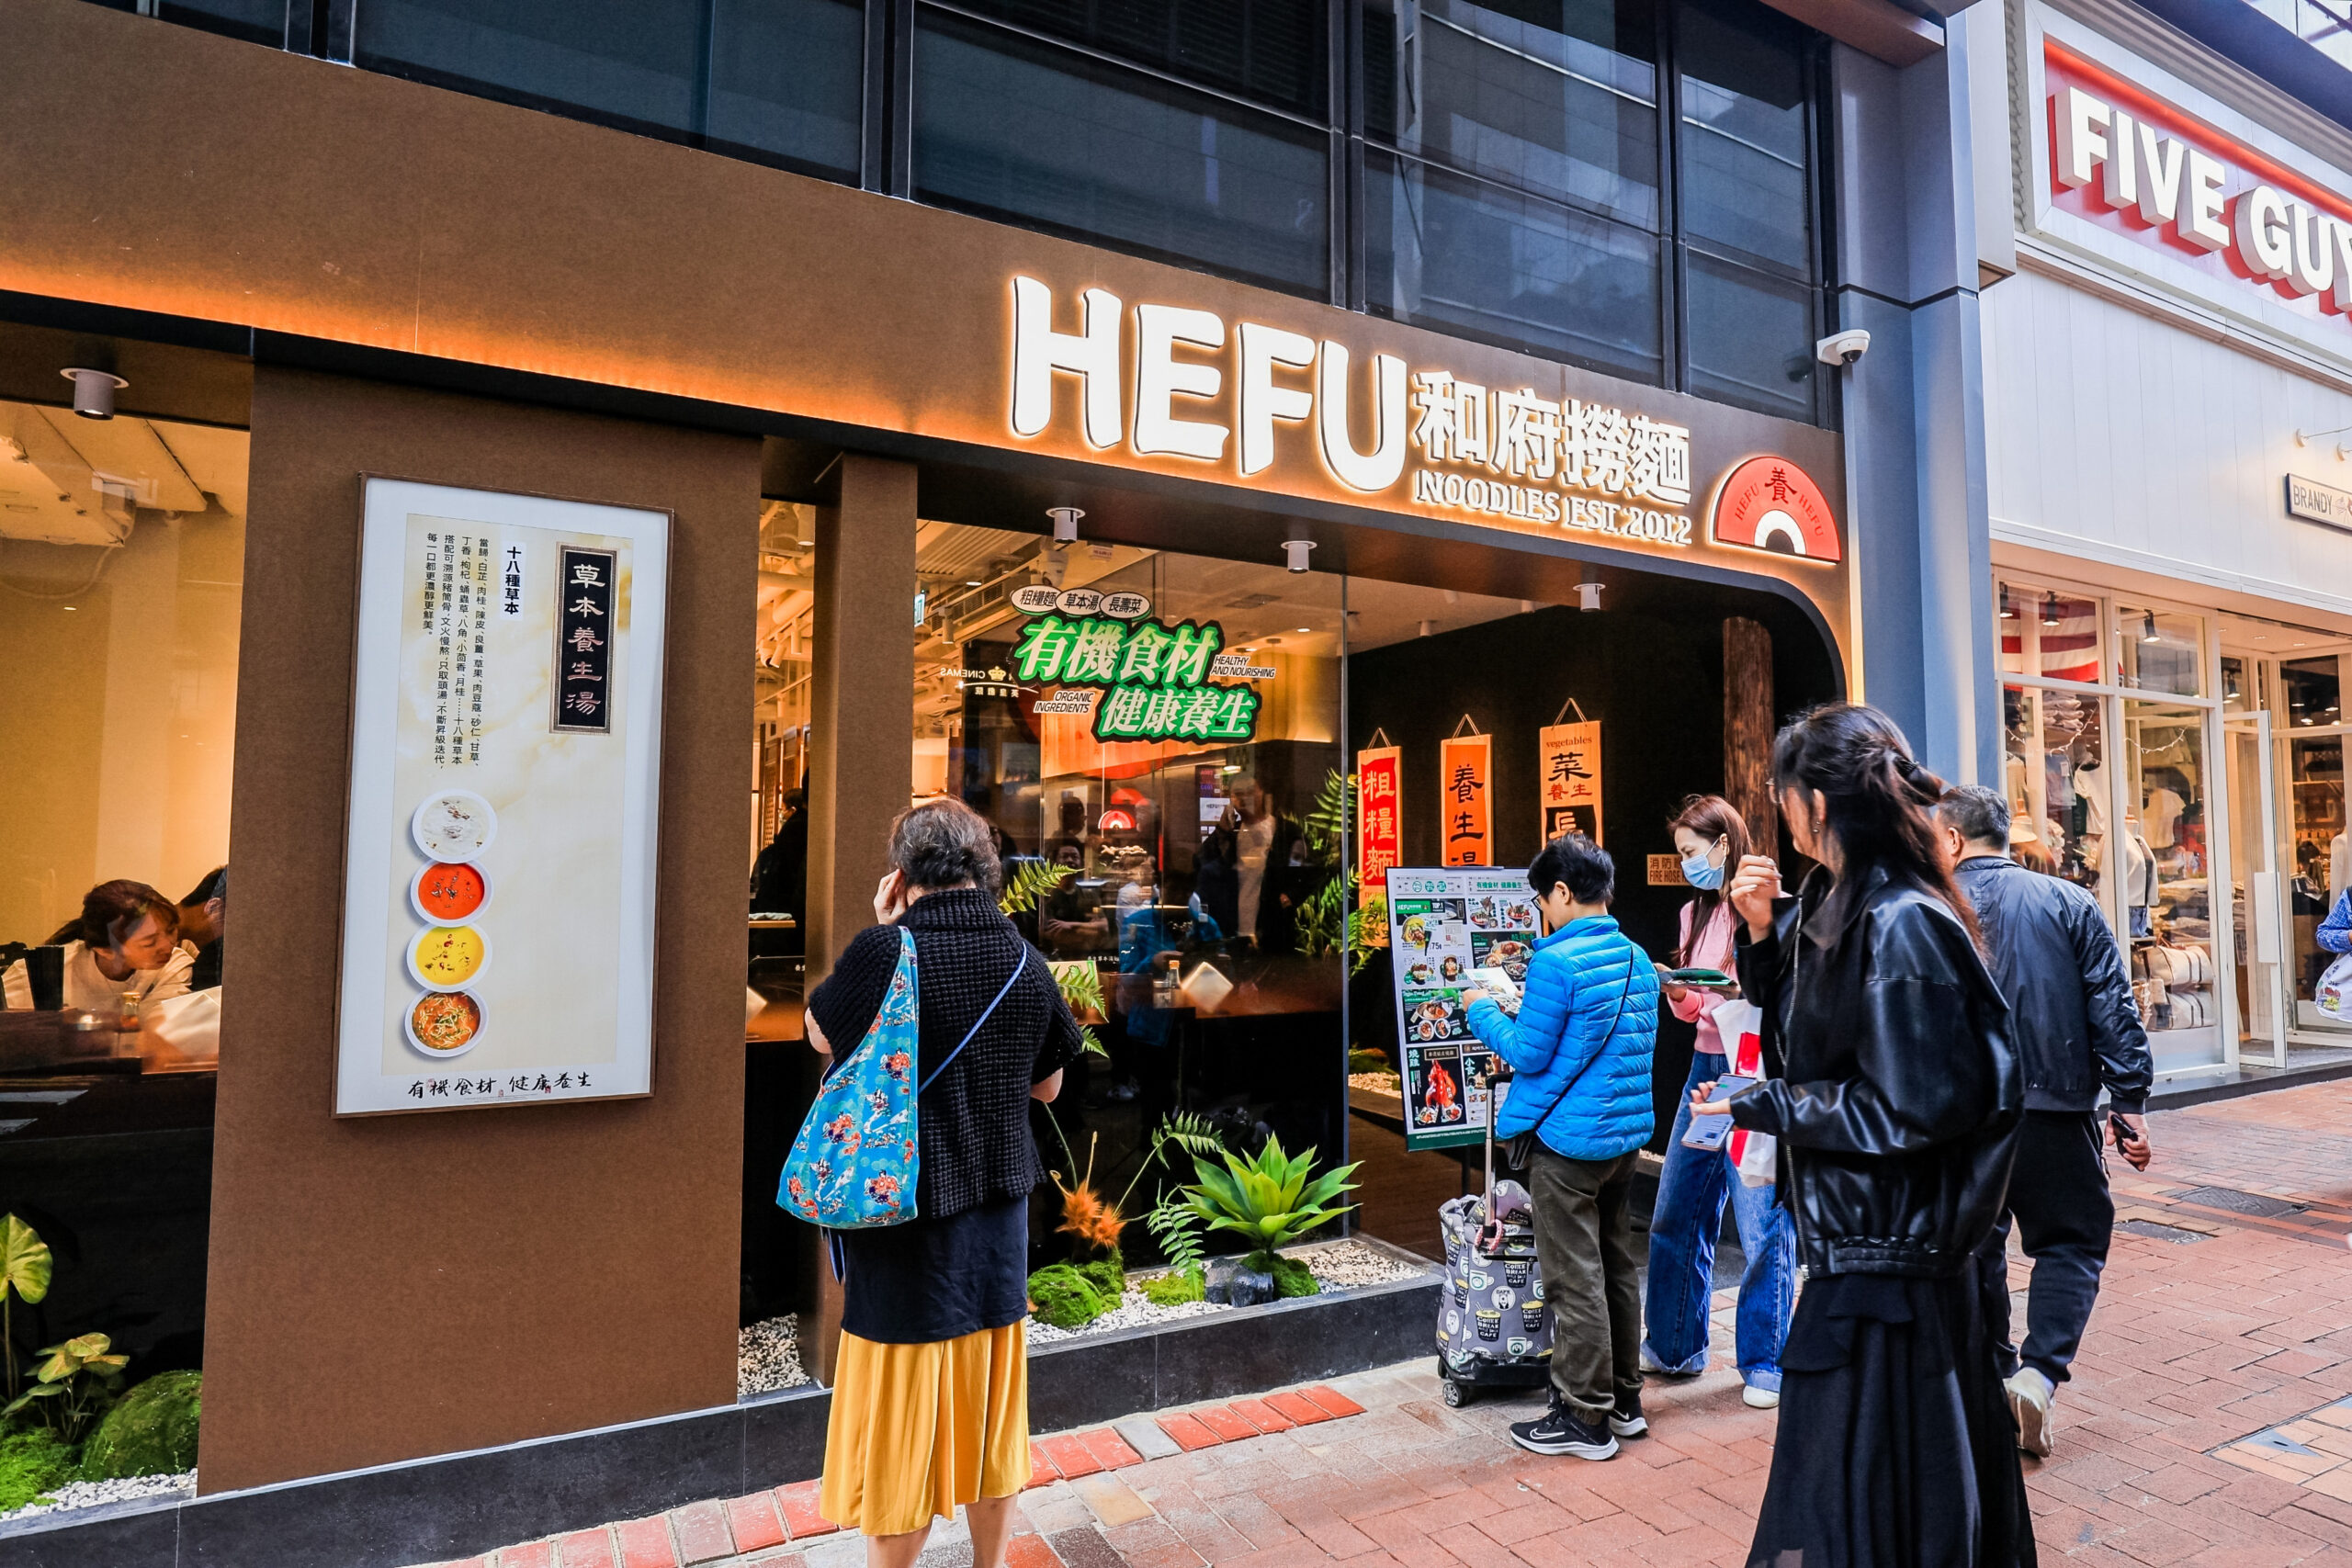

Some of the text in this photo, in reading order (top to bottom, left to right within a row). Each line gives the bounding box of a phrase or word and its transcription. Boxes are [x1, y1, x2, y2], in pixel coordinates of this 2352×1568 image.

[2052, 86, 2231, 254] FIVE
[1011, 276, 1408, 492] HEFU
[1412, 370, 1692, 505] 和府撈麵
[1416, 469, 1561, 523] NOODLES
[1764, 467, 1797, 504] 養
[2293, 484, 2333, 515] BRANDY
[1735, 482, 1759, 521] HEFU
[1798, 493, 1825, 537] HEFU
[504, 546, 522, 615] 十八種草本
[1020, 589, 1057, 607] 粗糧麵
[1064, 592, 1099, 611] 草本湯
[1108, 597, 1142, 614] 長壽菜
[565, 564, 605, 716] 草本養生湯
[1017, 617, 1217, 684] 有機食材
[1211, 665, 1275, 679] AND NOURISHING
[1214, 655, 1250, 667] HEALTHY
[1035, 702, 1091, 715] INGREDIENTS
[1055, 691, 1094, 703] ORGANIC
[1103, 686, 1254, 736] 健康養生
[1546, 736, 1593, 750] vegetables
[1548, 751, 1593, 783] 菜
[1547, 783, 1593, 801] 養生
[1649, 870, 1663, 883] FIRE
[1664, 870, 1680, 883] HOSE
[408, 1077, 497, 1099] 有機食材
